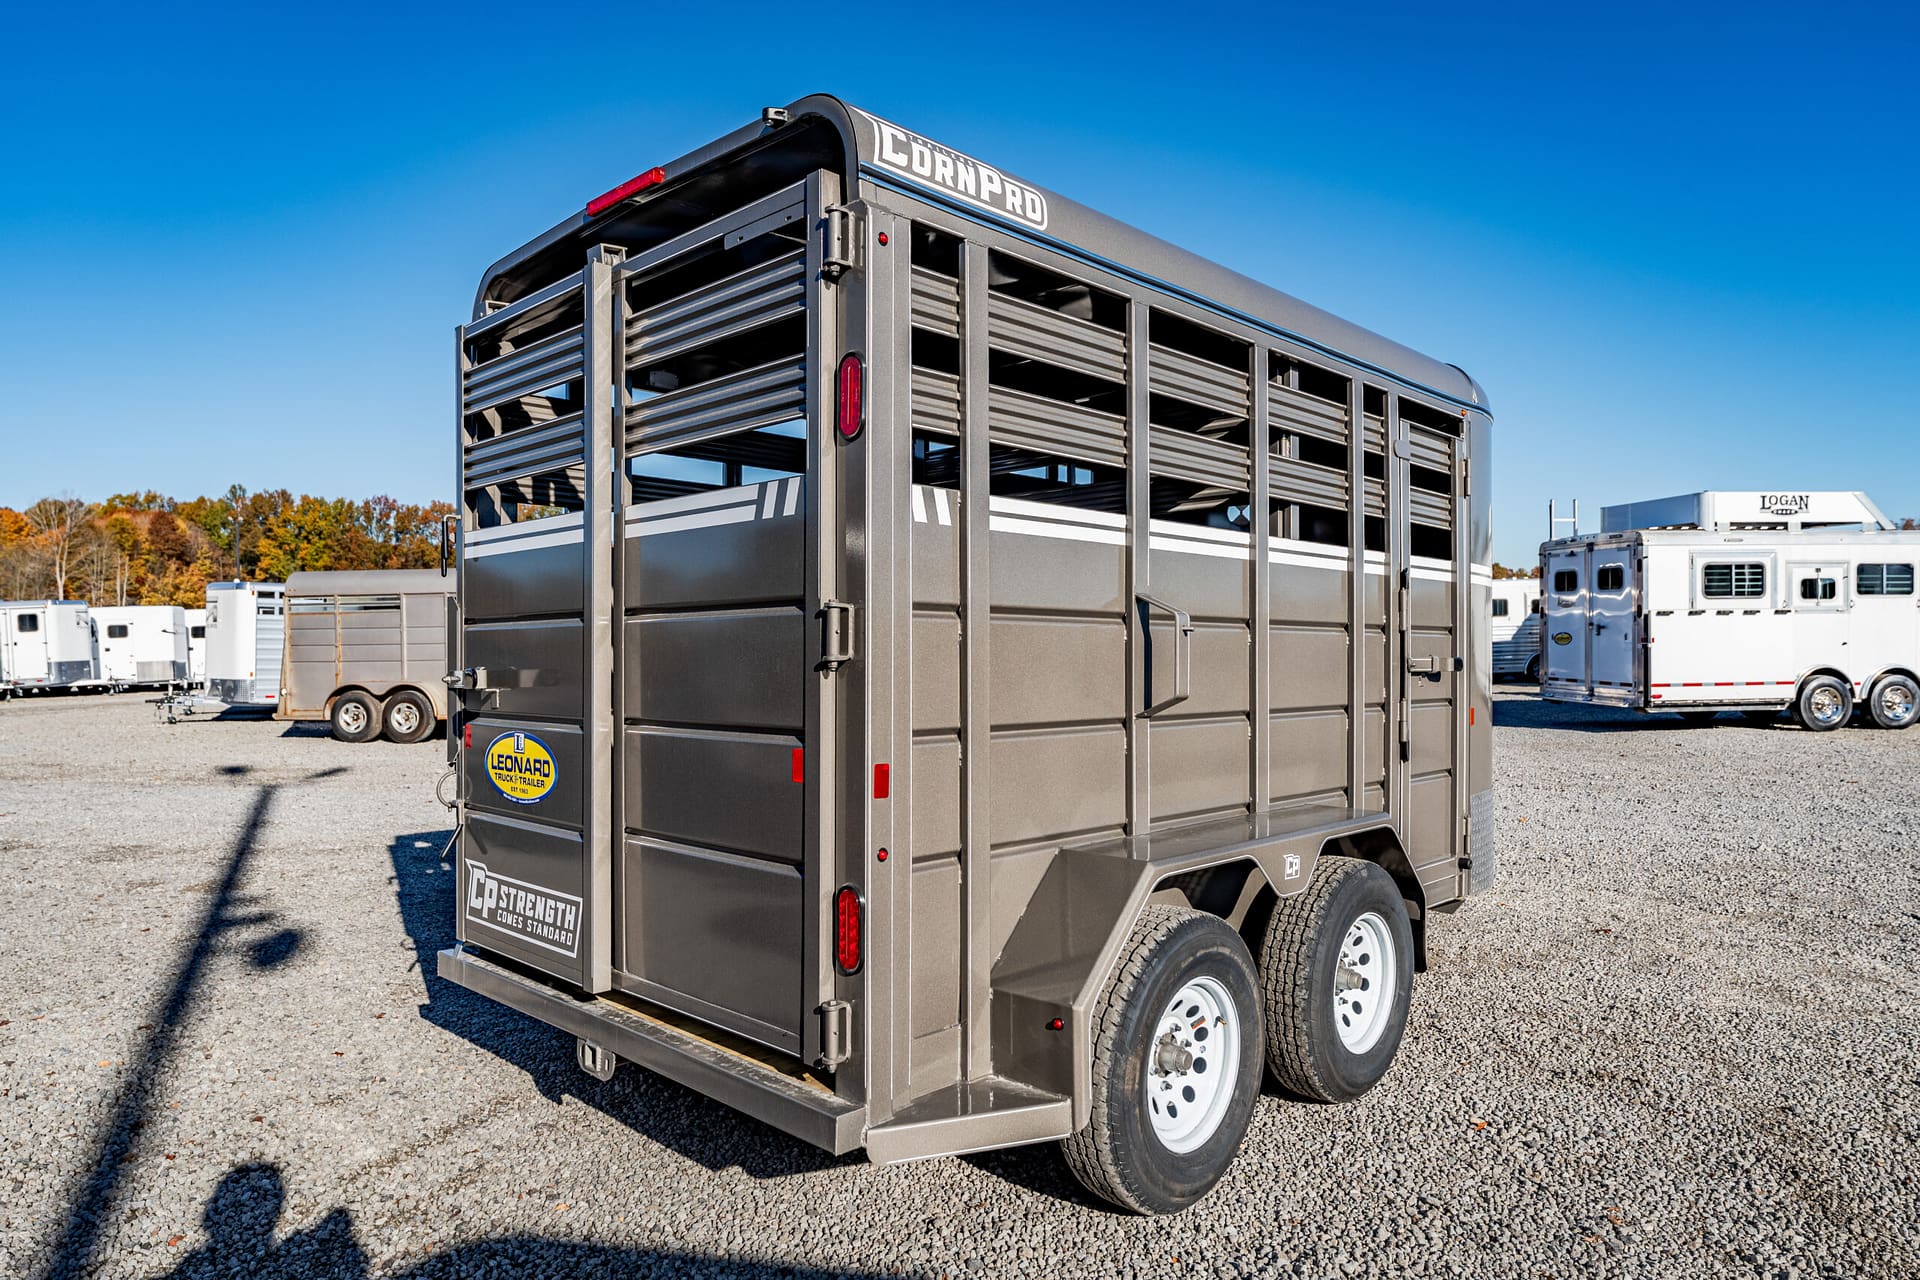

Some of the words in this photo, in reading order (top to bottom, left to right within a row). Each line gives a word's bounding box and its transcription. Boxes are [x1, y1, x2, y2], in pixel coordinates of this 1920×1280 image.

[1760, 494, 1809, 510] LOGAN
[491, 752, 550, 778] LEONARD
[494, 772, 514, 783] TRUCK
[519, 776, 545, 788] TRAILER
[1286, 856, 1299, 876] CP
[470, 867, 498, 919] CP
[499, 884, 576, 931] STRENGTH
[497, 909, 523, 929] COMES
[526, 919, 573, 946] STANDARD
